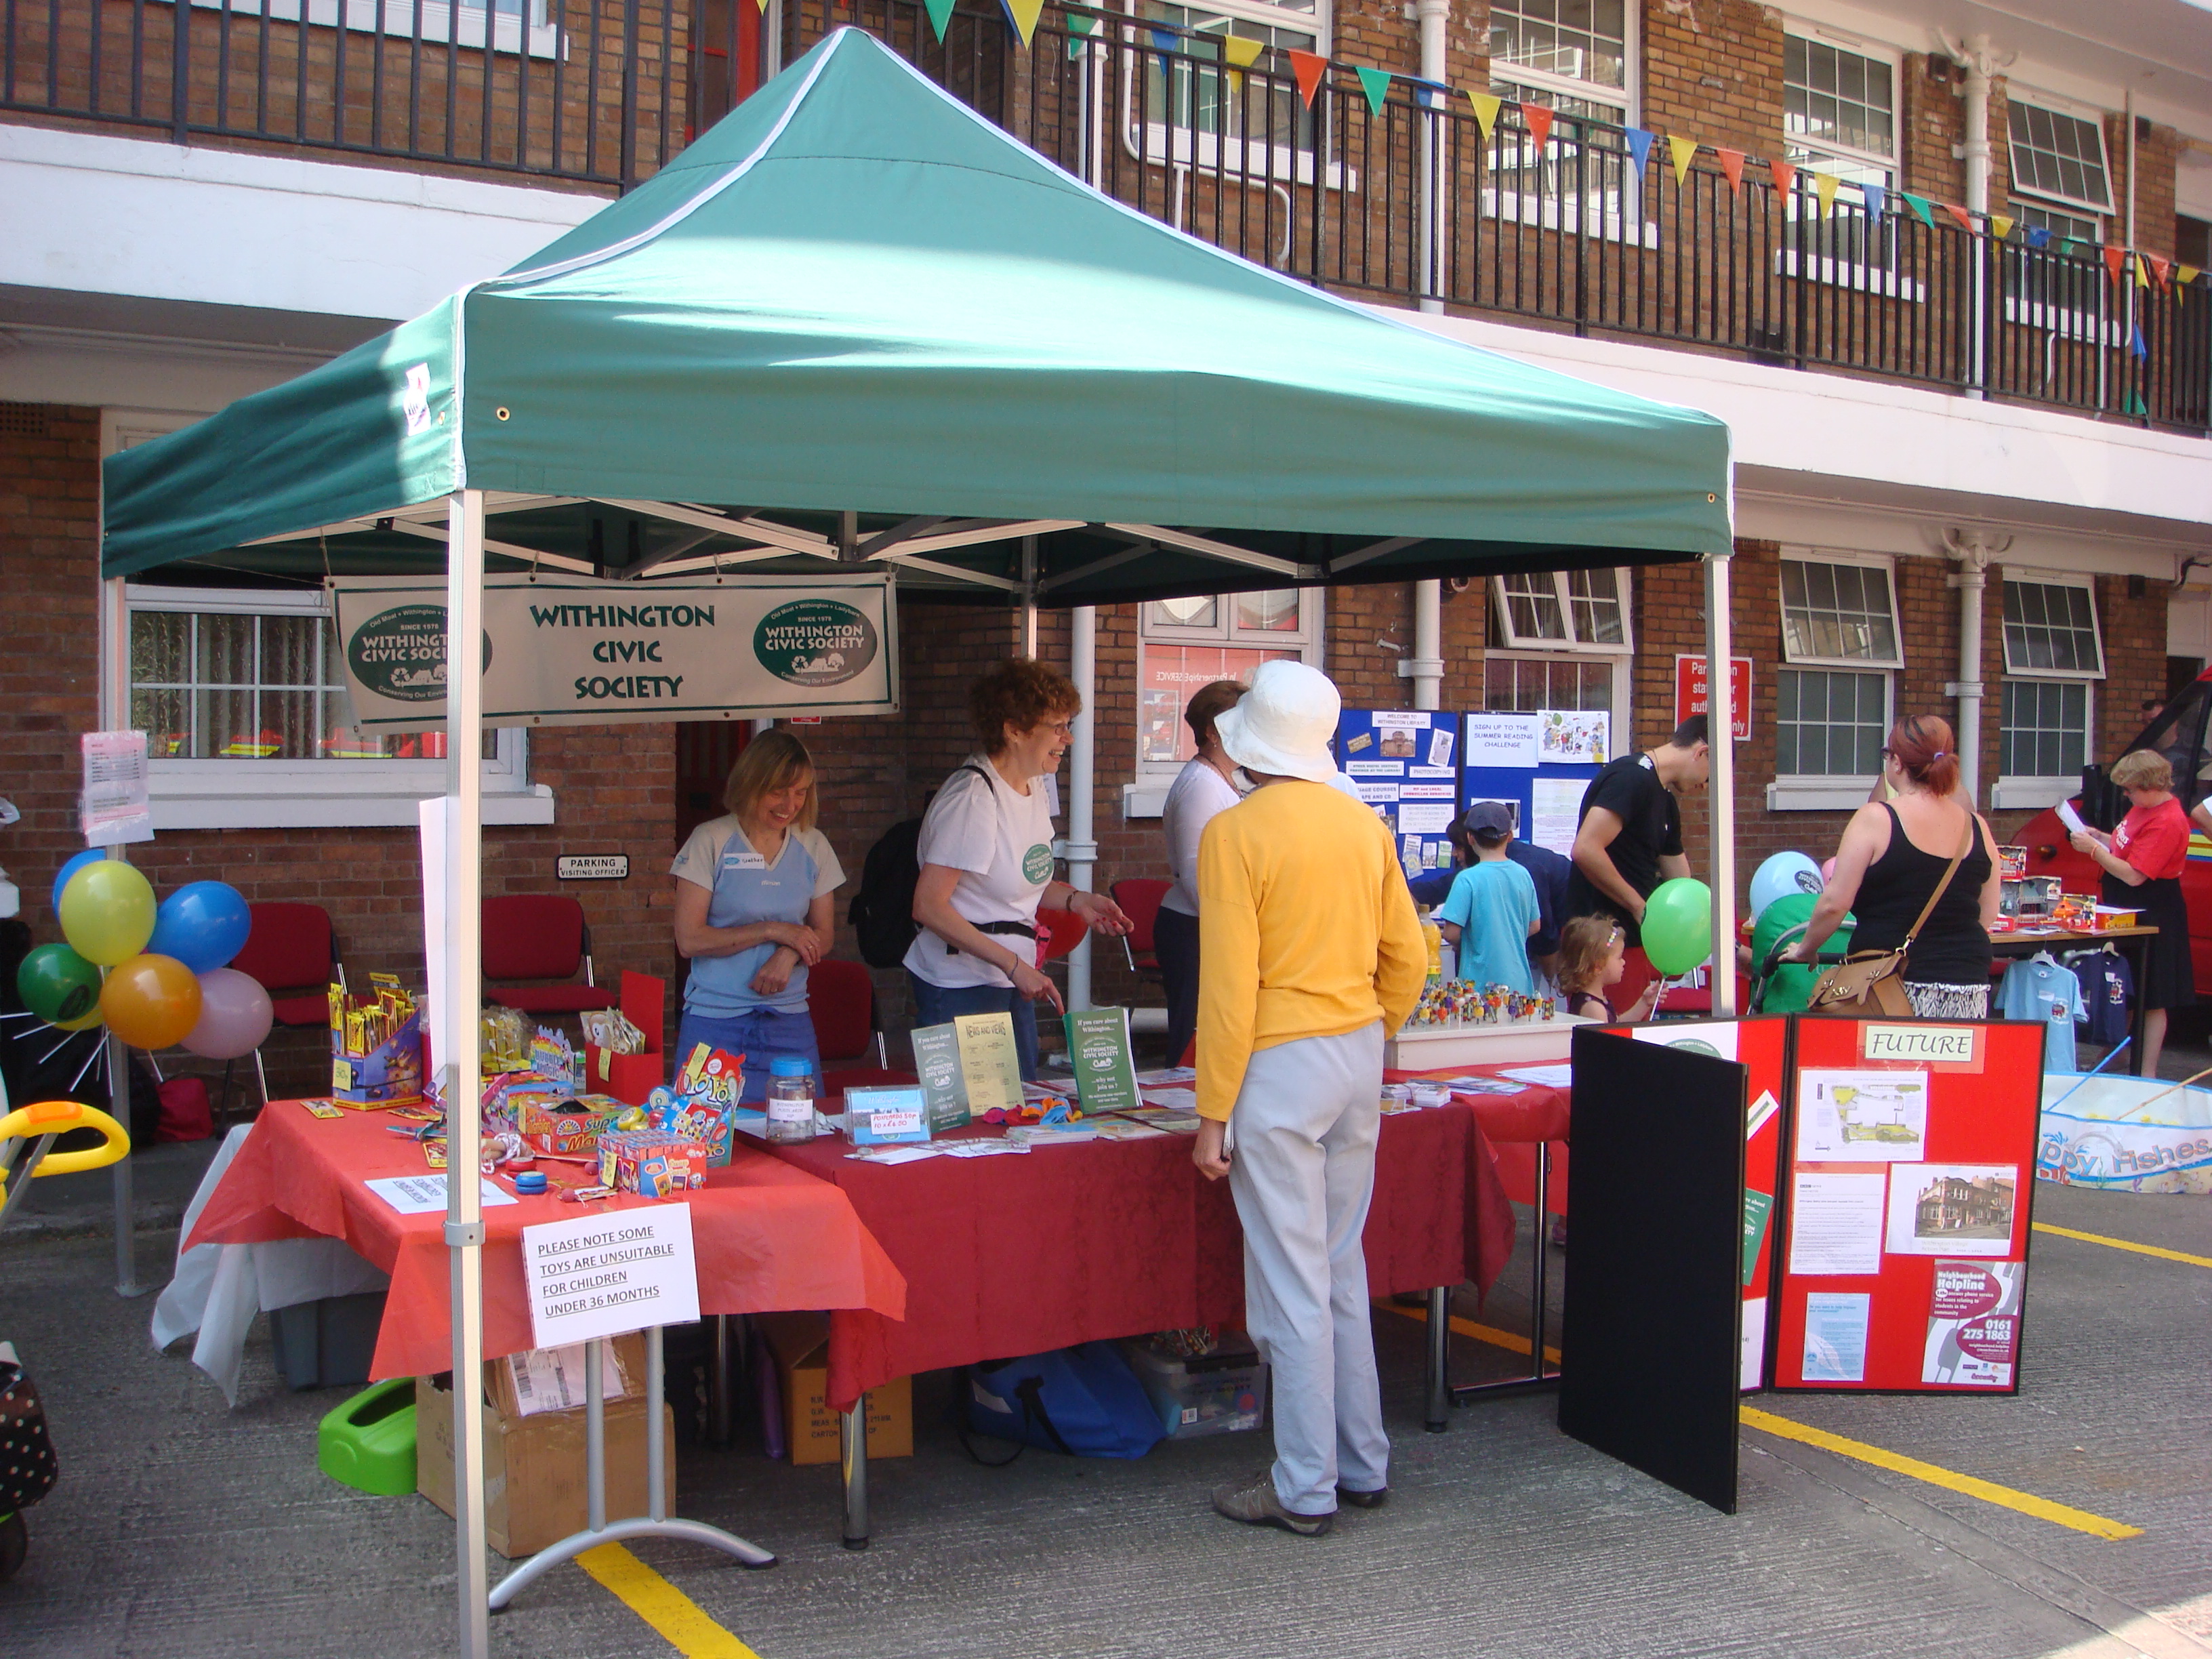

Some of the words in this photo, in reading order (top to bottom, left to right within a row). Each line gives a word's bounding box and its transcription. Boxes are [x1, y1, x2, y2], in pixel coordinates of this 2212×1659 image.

[529, 605, 714, 628] WITHINGTON
[771, 611, 781, 619] Old
[781, 606, 795, 615] Moat
[834, 605, 861, 617] Ladybarn
[370, 619, 381, 628] Old
[382, 612, 396, 622] Moat
[765, 625, 863, 638] WITHINGTON
[362, 634, 448, 649] WITHINGT
[765, 638, 805, 651] CIVIC
[808, 636, 864, 649] SOCIETY
[361, 649, 407, 662] CIVIC
[411, 647, 448, 660] SOCI
[593, 640, 662, 663] CIVIC
[378, 685, 413, 699] Conserving
[575, 675, 683, 699] SOCIETY
[571, 859, 615, 867] PARKING
[966, 1024, 981, 1039] NEWS
[981, 1025, 990, 1035] AND
[991, 1021, 1006, 1036] VIEWS
[1872, 1033, 1971, 1054] FUTURE
[905, 1112, 917, 1120] 50p
[2039, 1141, 2098, 1176] ppy
[2112, 1139, 2210, 1173] Fishes
[538, 1239, 579, 1255] PLEASE
[583, 1232, 615, 1247] NOTE
[618, 1226, 654, 1240] SOME
[540, 1261, 571, 1275] TOYS
[574, 1256, 596, 1269] ARE
[600, 1244, 674, 1263] UNSUITABLE
[543, 1283, 567, 1296] FOR
[570, 1271, 628, 1290] CHILDREN
[1938, 1271, 1986, 1281] Neighbourhood
[1937, 1279, 1985, 1291] Helpline
[545, 1299, 587, 1316] UNDER
[590, 1295, 604, 1308] 36
[607, 1286, 660, 1303] MONTHS
[1985, 1319, 2011, 1330] 0161
[1963, 1328, 1984, 1339] 275
[1985, 1330, 2011, 1340] 1863
